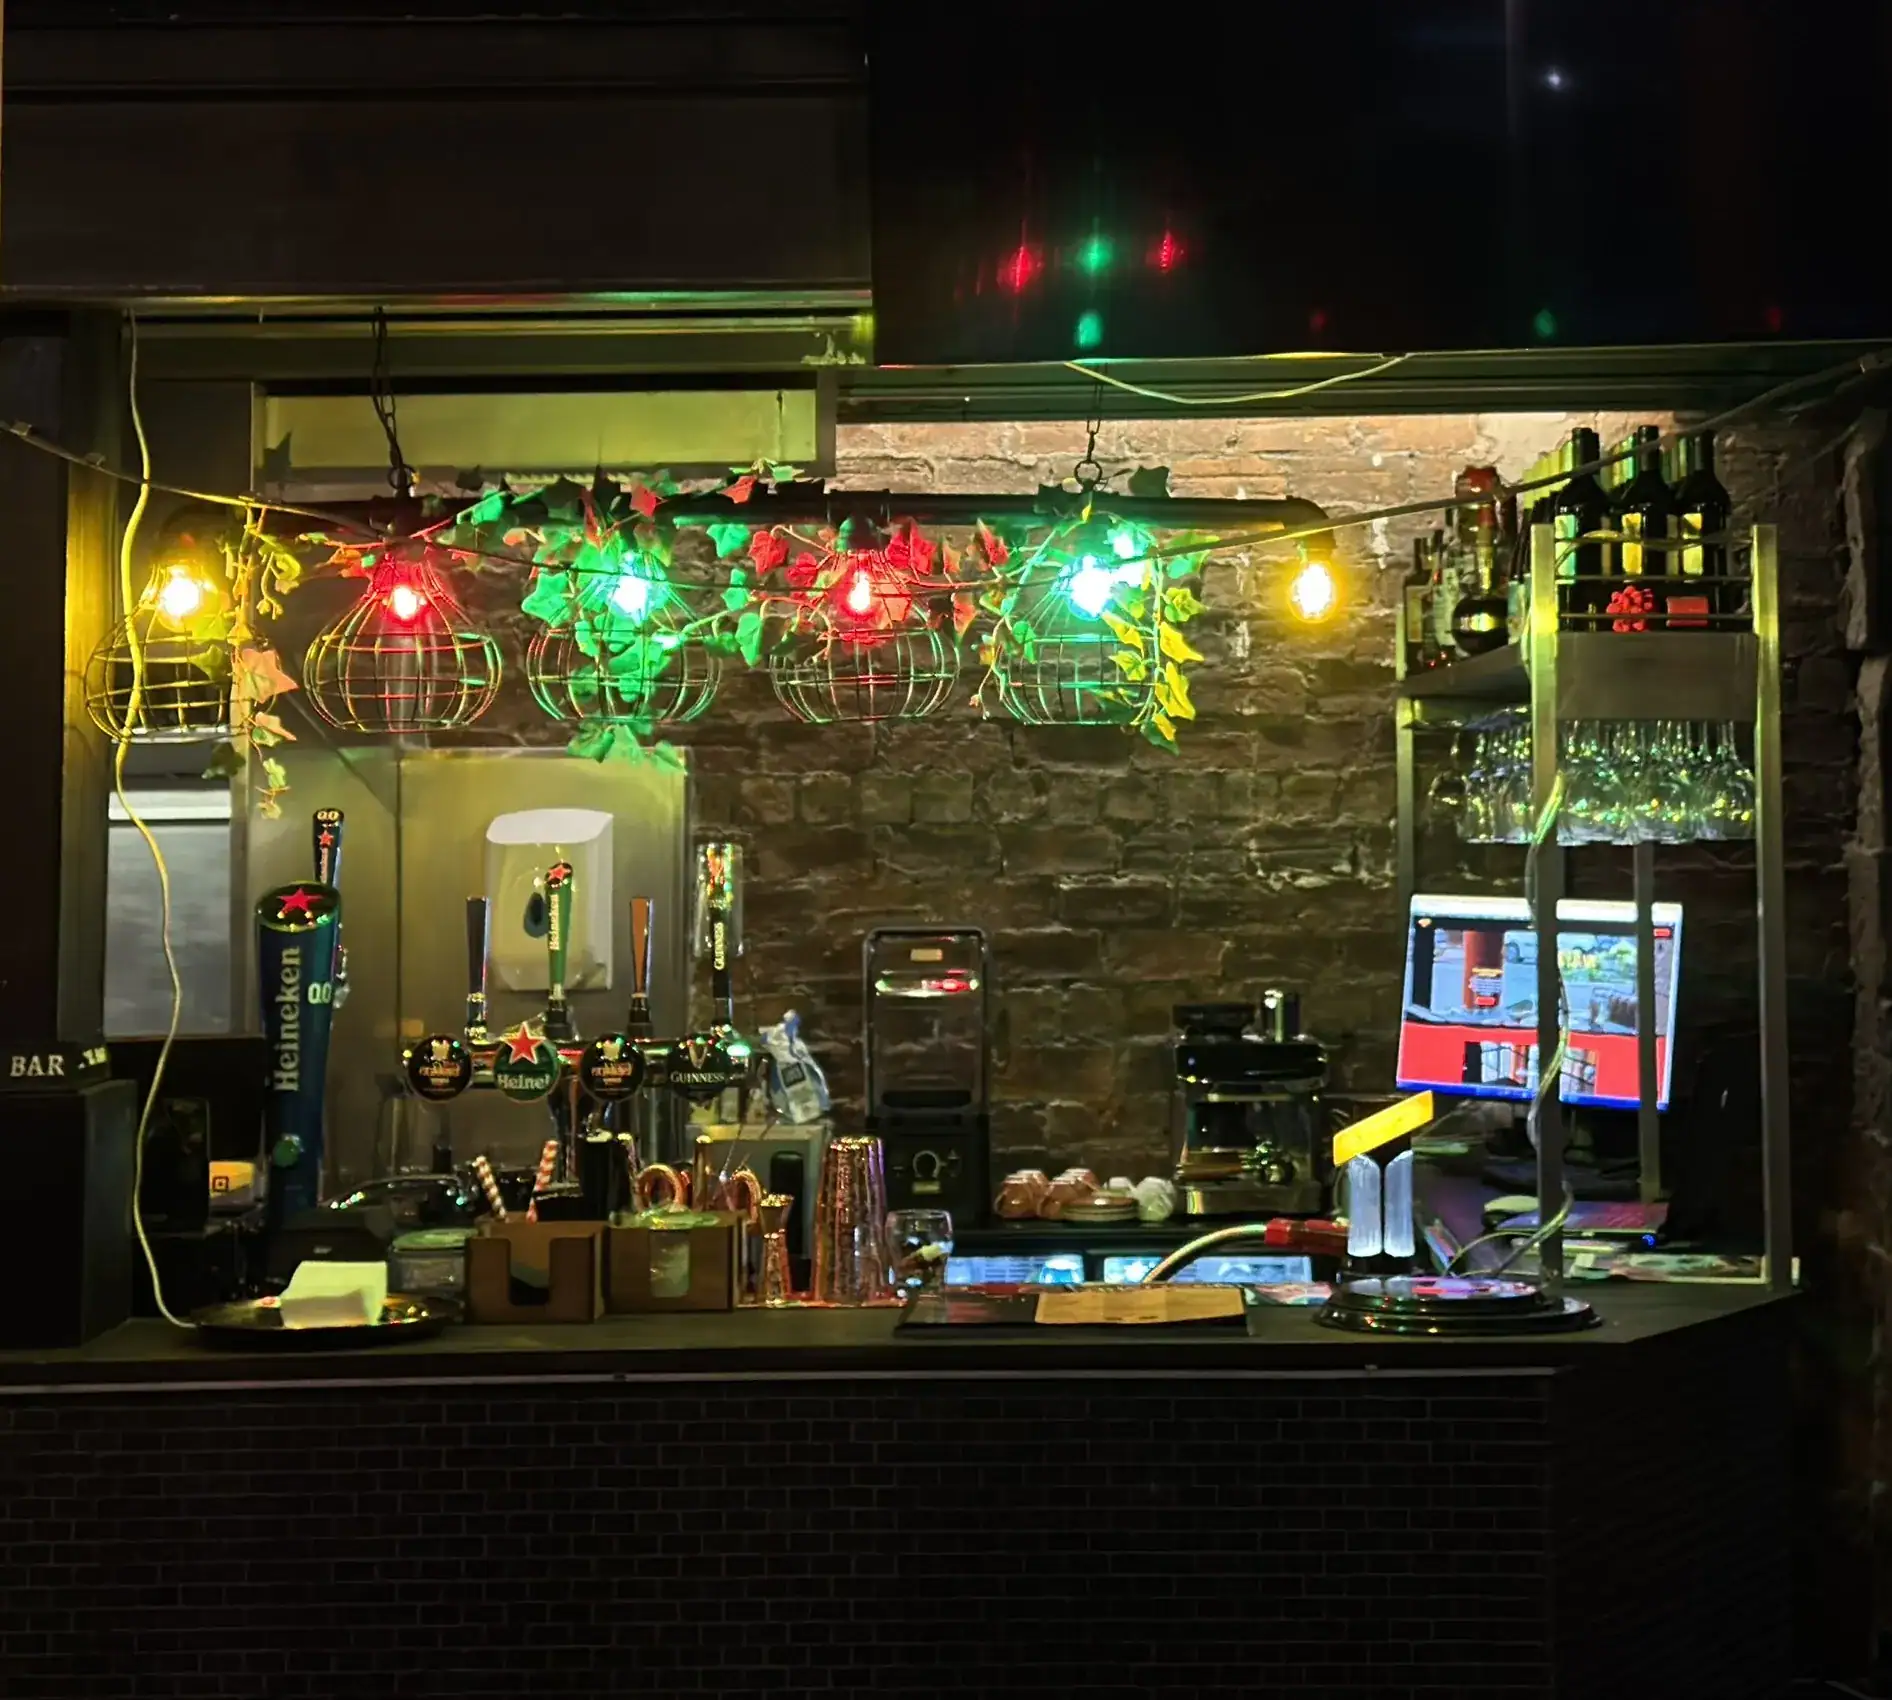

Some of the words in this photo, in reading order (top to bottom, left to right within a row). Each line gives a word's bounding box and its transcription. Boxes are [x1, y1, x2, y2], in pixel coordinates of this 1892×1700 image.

[273, 945, 301, 1092] Heineken
[10, 1054, 65, 1077] BAR
[669, 1070, 726, 1085] GUINNESS
